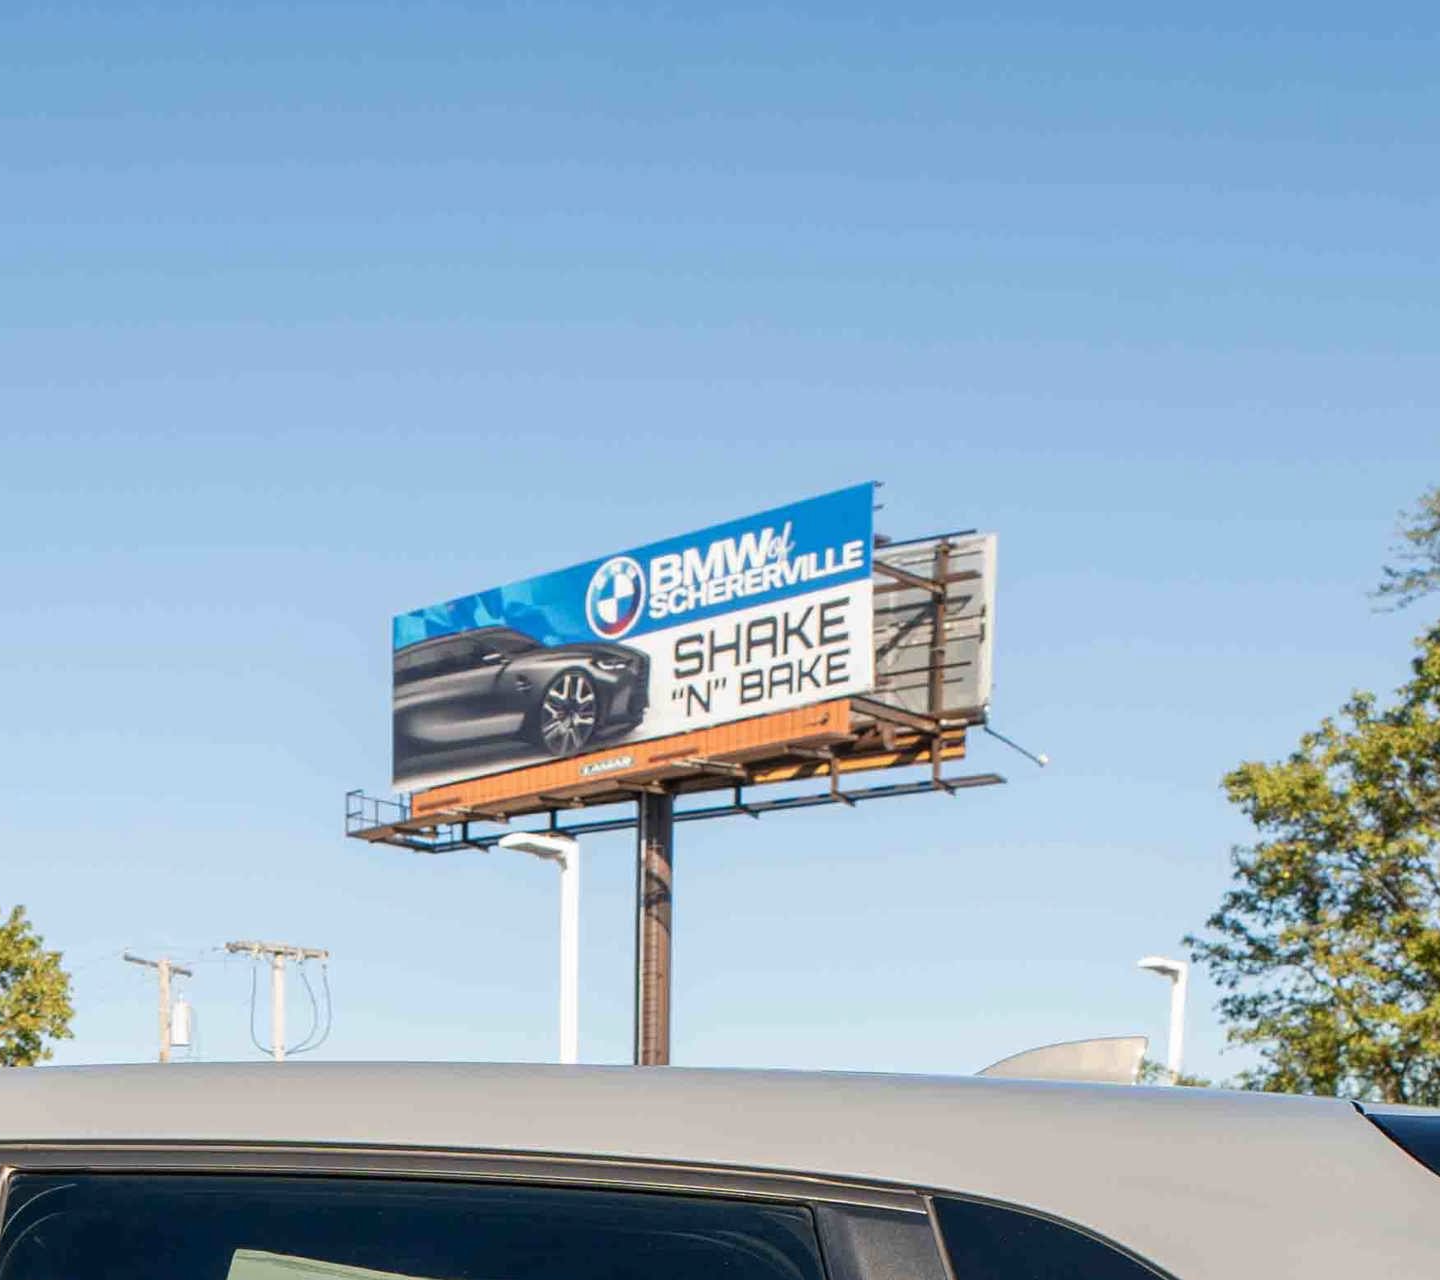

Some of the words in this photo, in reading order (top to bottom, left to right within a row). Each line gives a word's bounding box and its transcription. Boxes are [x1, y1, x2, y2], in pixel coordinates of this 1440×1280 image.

[648, 540, 864, 619] SCHERERVILLE
[649, 527, 774, 592] BMW
[770, 521, 797, 563] of
[674, 596, 850, 680] SHAKE
[740, 648, 850, 705] BAKE
